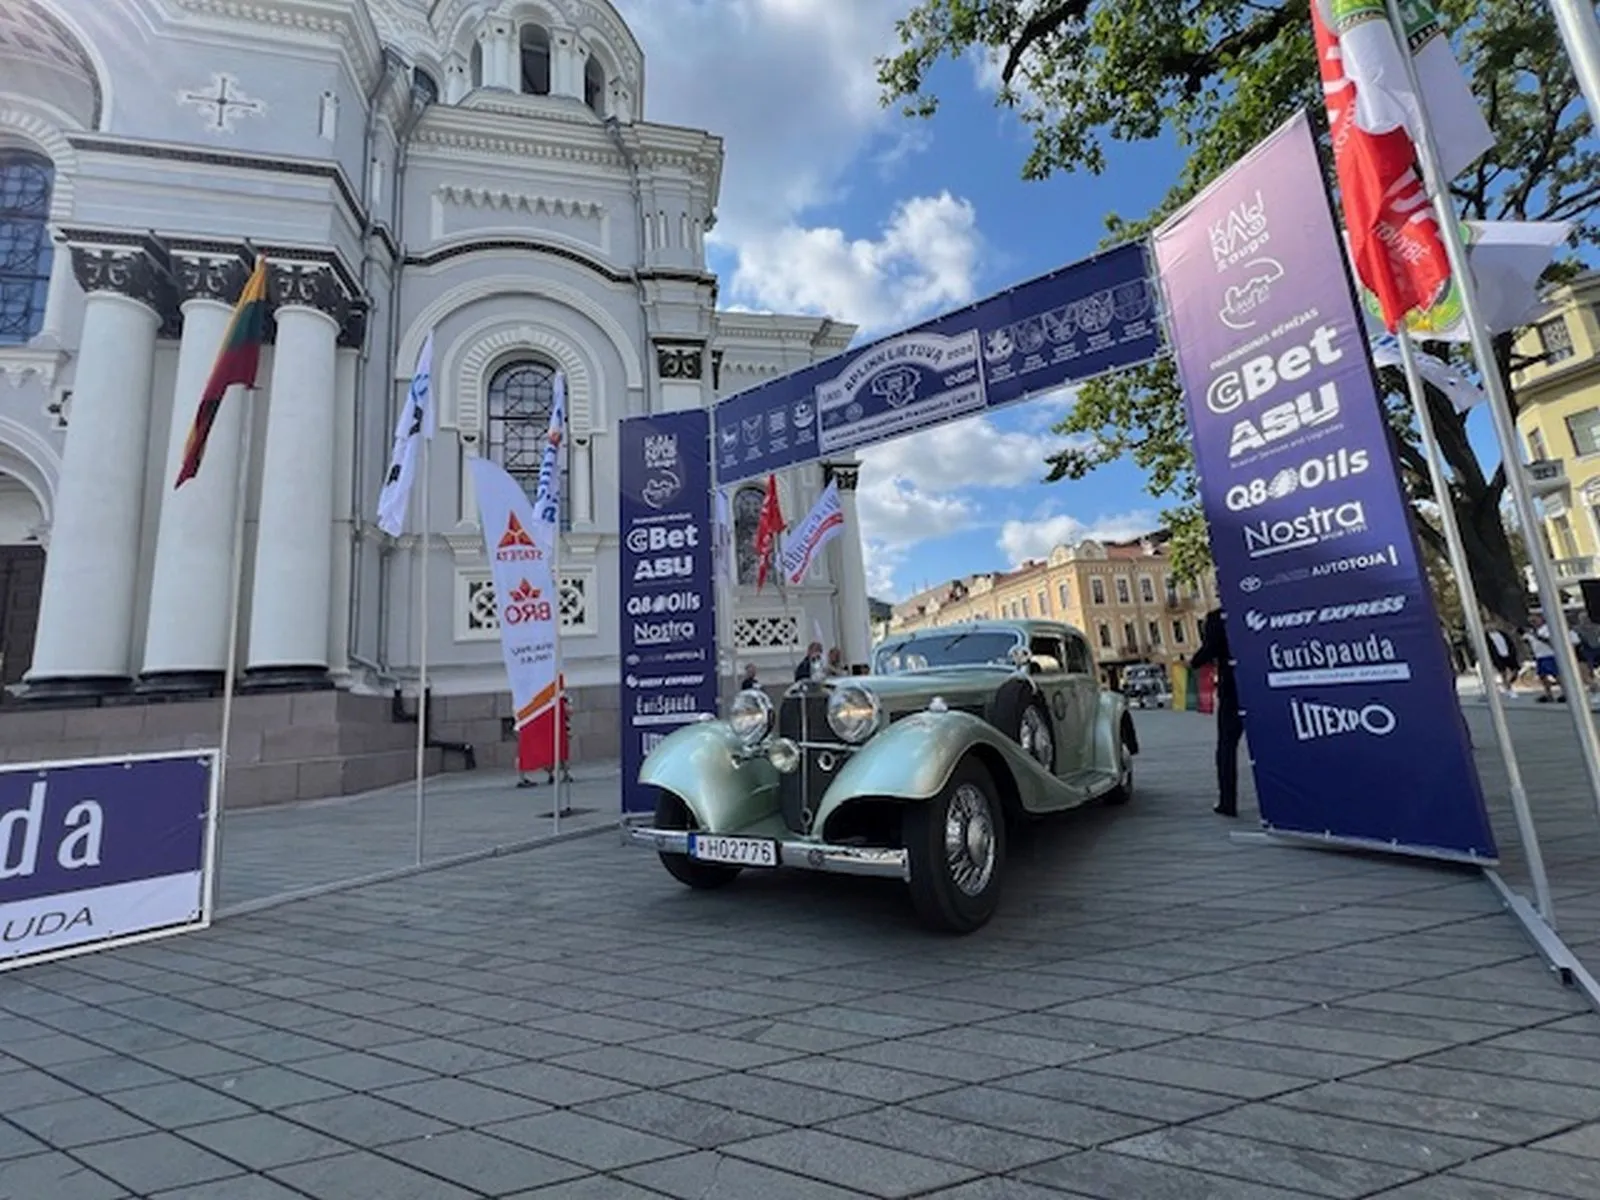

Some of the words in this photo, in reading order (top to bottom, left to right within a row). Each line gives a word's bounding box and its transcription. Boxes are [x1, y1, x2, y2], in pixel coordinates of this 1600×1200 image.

[1228, 381, 1340, 459] ASU
[1226, 478, 1267, 511] Q8
[1300, 447, 1370, 488] Oils
[1243, 501, 1366, 551] Nostra
[633, 555, 693, 580] ASU
[1311, 552, 1386, 577] AUTOTOJA
[667, 592, 700, 612] Oils
[1269, 610, 1317, 630] WEST
[1318, 595, 1406, 623] EXPRESS
[633, 620, 695, 640] Nostra
[1290, 697, 1396, 740] LITEXPO
[707, 839, 772, 864] H02776
